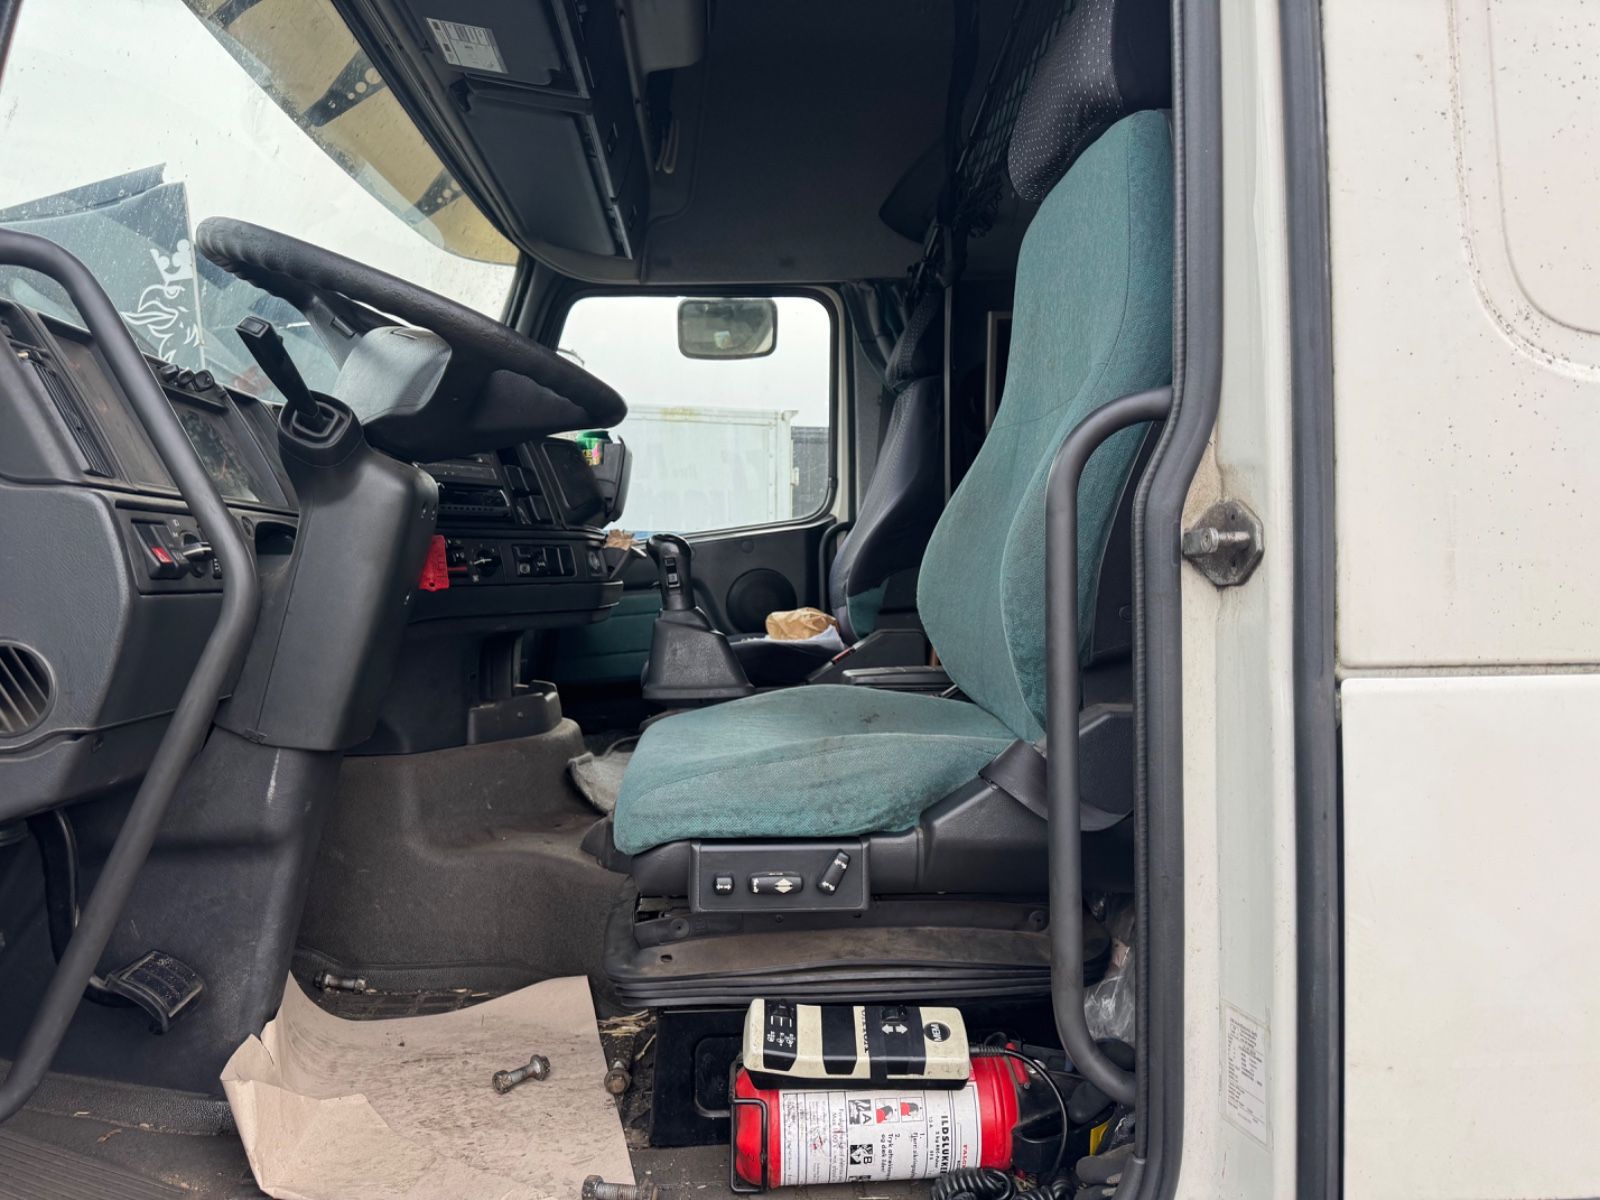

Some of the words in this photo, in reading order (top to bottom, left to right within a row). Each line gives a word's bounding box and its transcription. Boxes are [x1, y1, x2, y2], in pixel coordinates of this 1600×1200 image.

[862, 1113, 872, 1125] A
[880, 1134, 886, 1143] og
[863, 1156, 873, 1165] B
